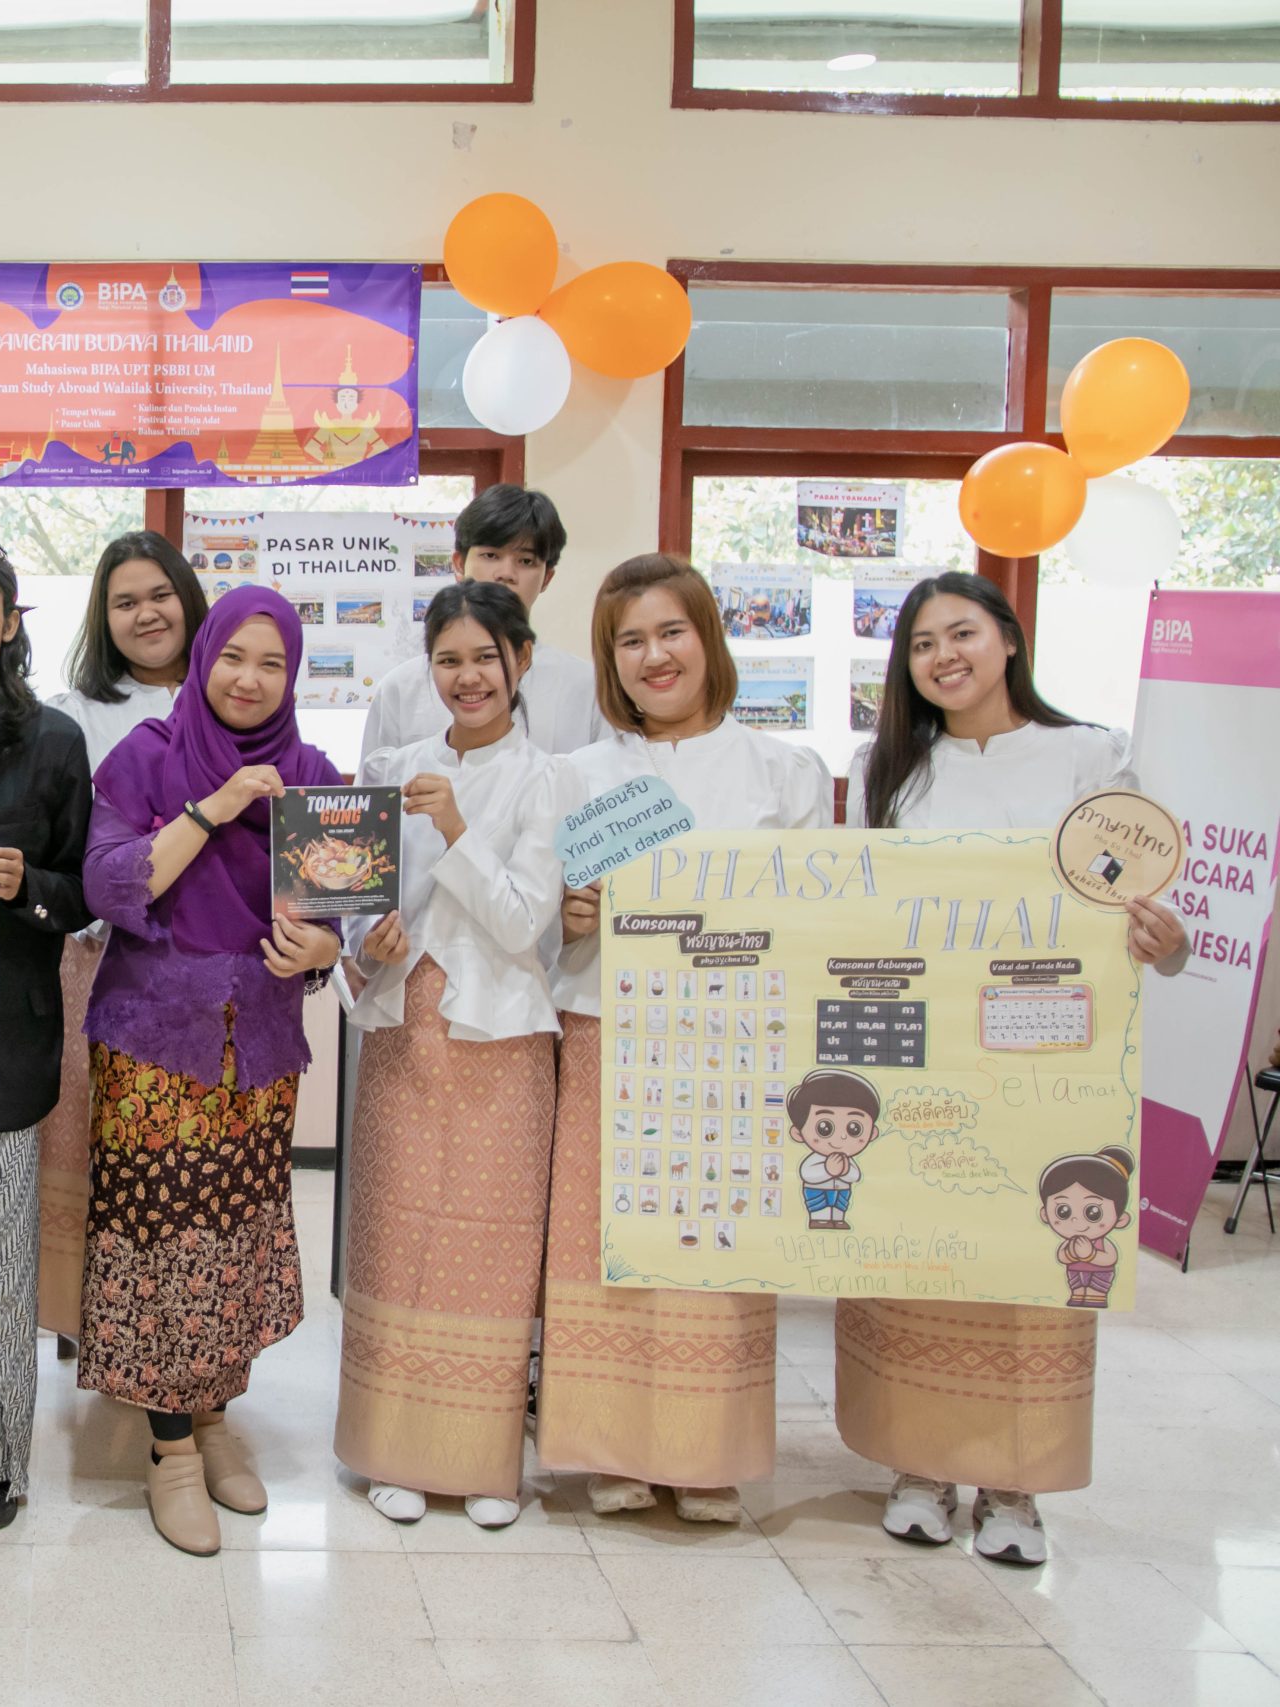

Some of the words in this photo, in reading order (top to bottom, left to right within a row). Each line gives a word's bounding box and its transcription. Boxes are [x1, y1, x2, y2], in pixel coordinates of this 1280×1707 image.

[85, 334, 157, 352] BUDAYA
[164, 334, 254, 353] THAILAND
[26, 363, 87, 375] Mahasiswa
[91, 364, 120, 376] BIPA
[123, 364, 150, 375] UPT
[154, 364, 190, 376] PSBBI
[194, 365, 215, 376] UM
[22, 382, 54, 396] Study
[57, 382, 99, 393] Abroad
[103, 382, 152, 394] Walailak
[156, 383, 216, 397] University,
[220, 383, 272, 395] Thailand
[61, 408, 89, 418] Tempat
[91, 408, 116, 417] Wisata
[139, 404, 167, 412] Kuliner
[169, 404, 183, 412] dan
[185, 405, 212, 413] Produk
[214, 405, 237, 413] Instan
[61, 420, 81, 428] Pasar
[83, 420, 101, 428] Unik
[139, 416, 167, 424] Festival
[169, 416, 183, 424] dan
[202, 416, 220, 425] Adat
[266, 537, 335, 552] PASAR
[343, 536, 391, 551] UNIK
[272, 562, 291, 575] DI
[298, 559, 397, 575] THAILAND
[307, 794, 371, 813] TOMYAM
[565, 779, 650, 831] ยินดีต้อนรับ
[320, 808, 362, 826] GUNG
[564, 832, 605, 861] Yindi
[605, 796, 673, 838] Thonrab
[1078, 806, 1173, 857] ภาษาไทย
[1203, 823, 1267, 861] SUKA
[567, 848, 633, 888] Selamat
[634, 816, 691, 852] datang
[648, 844, 878, 902] PHASA
[1183, 857, 1254, 895] ICARA
[619, 914, 697, 931] Konsonan
[828, 959, 875, 969] Konsonan
[992, 963, 1014, 971] Vokal
[1015, 962, 1030, 970] dan
[1031, 962, 1054, 970] Tanda
[1056, 961, 1075, 969] Nada
[889, 1097, 968, 1123] สวัสดีครับ
[802, 1265, 890, 1295] Terima
[905, 1267, 966, 1296] kasih
